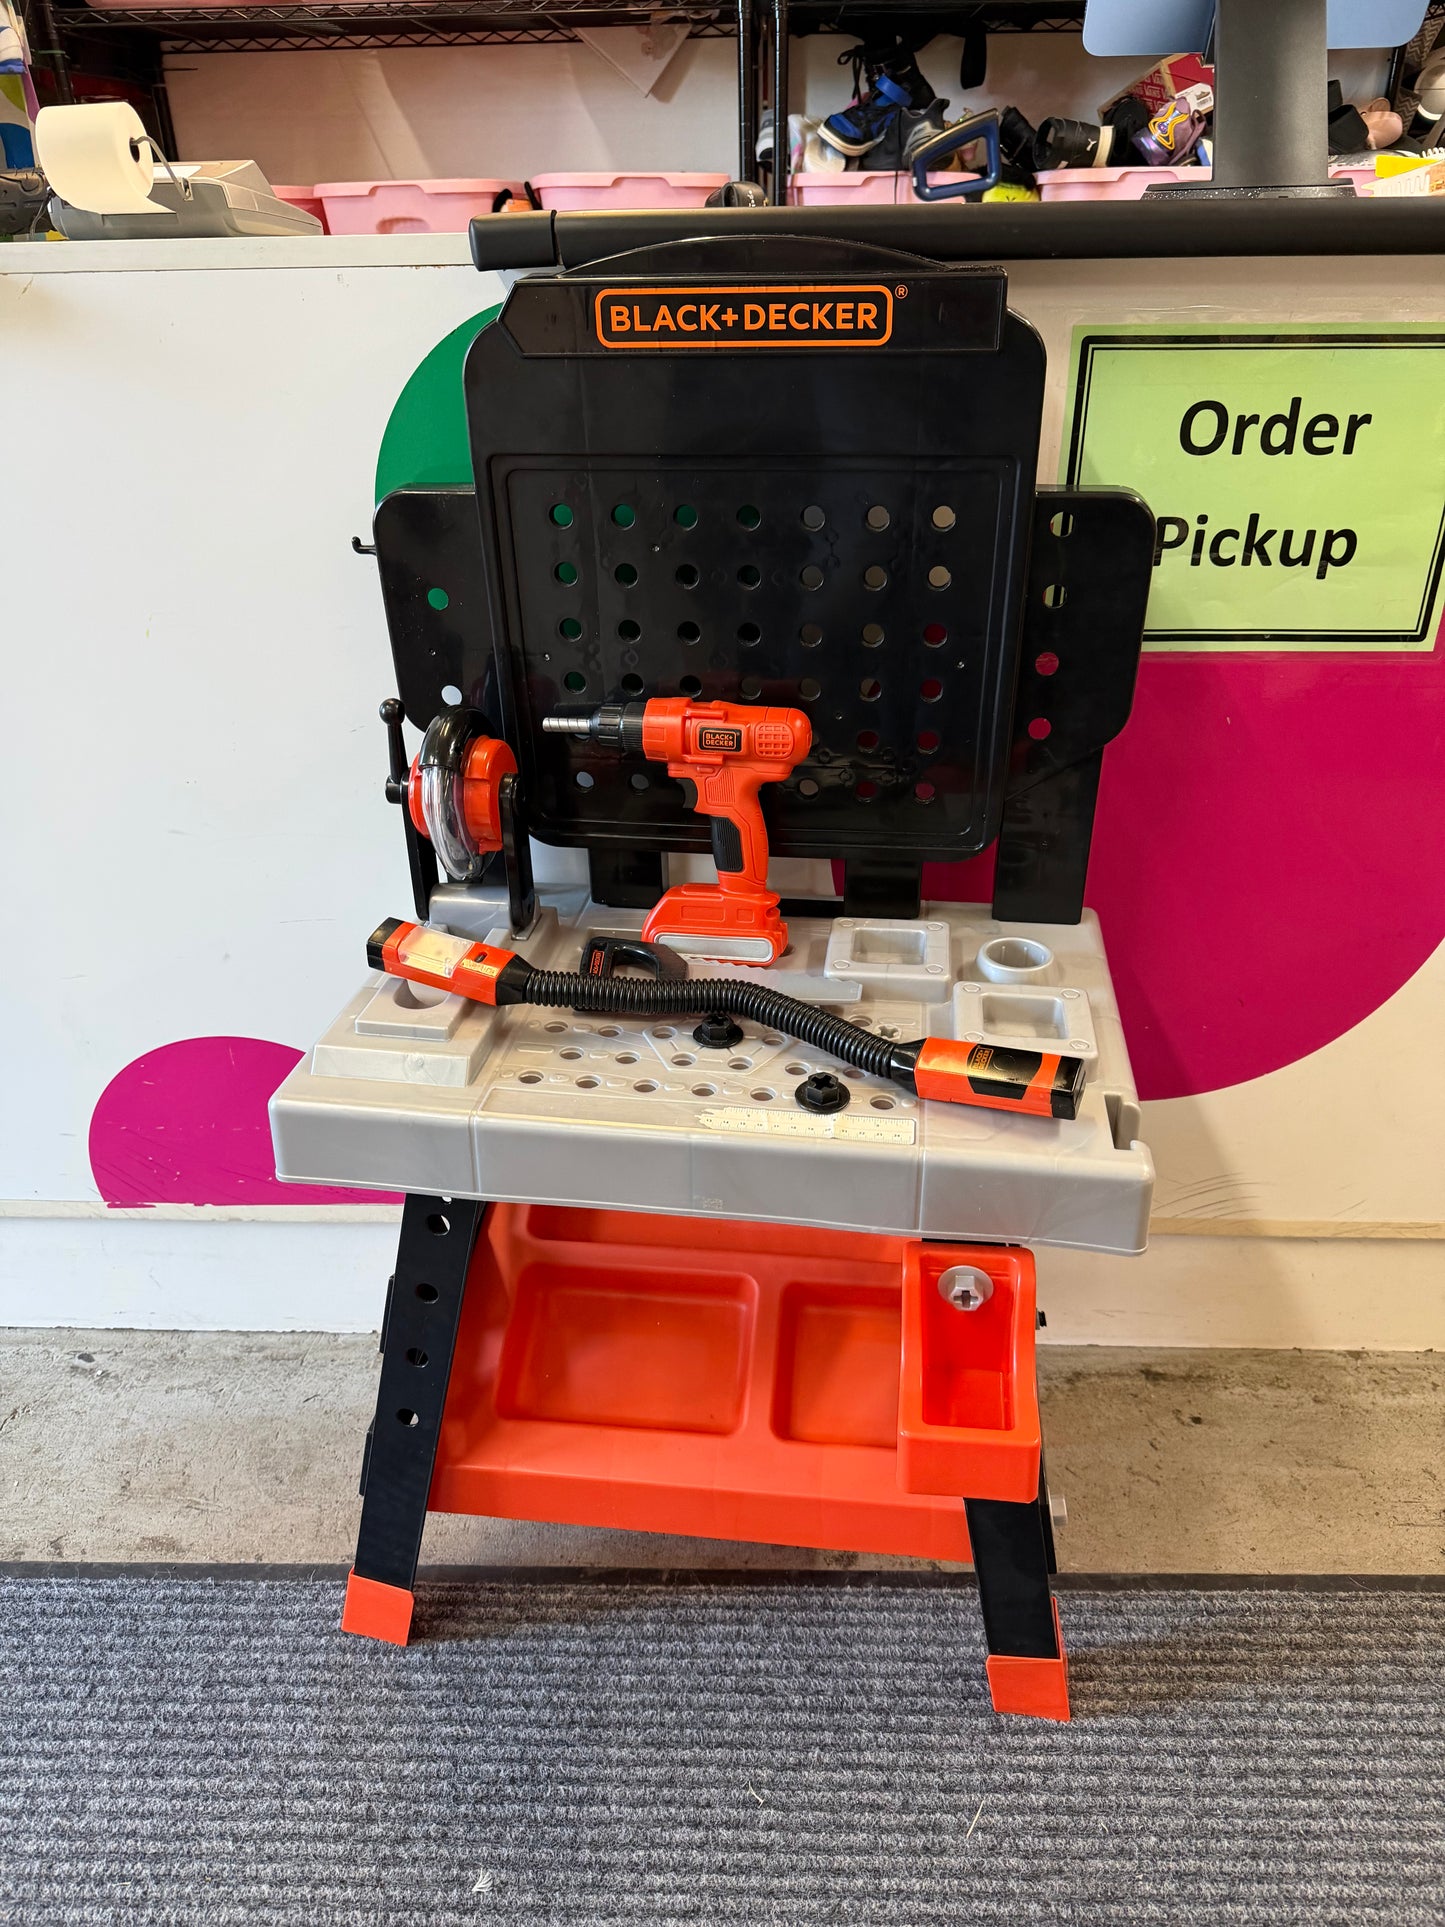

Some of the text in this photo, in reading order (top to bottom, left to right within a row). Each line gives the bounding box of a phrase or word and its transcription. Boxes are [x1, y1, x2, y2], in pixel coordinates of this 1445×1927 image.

[610, 303, 877, 332] BLACK+DECKER
[1179, 397, 1372, 456] Order
[1153, 513, 1358, 580] Pickup
[705, 733, 733, 741] BLACK+
